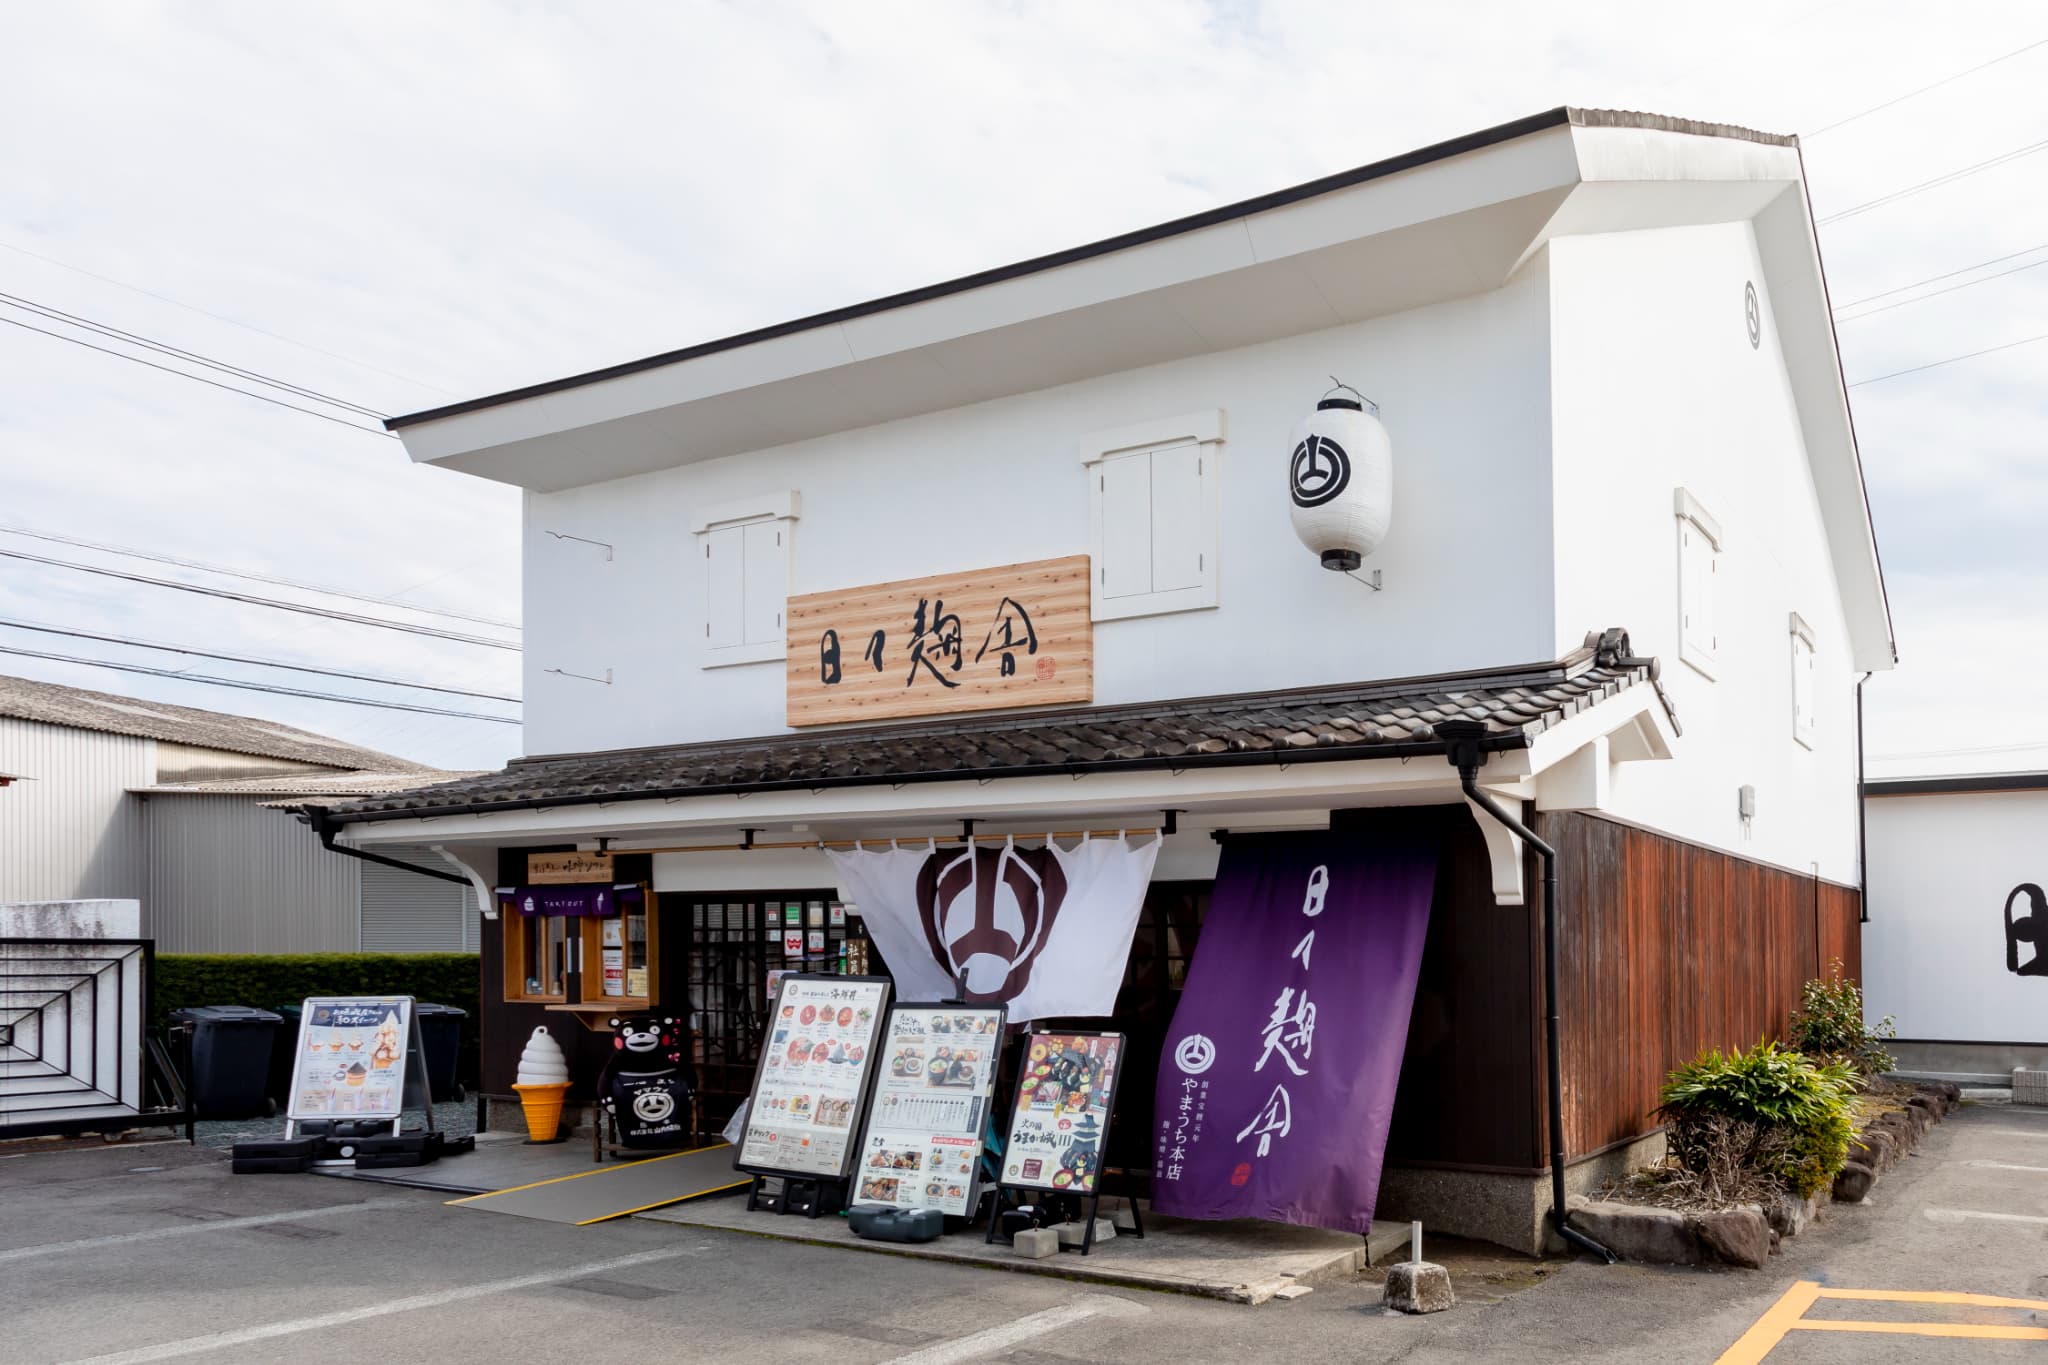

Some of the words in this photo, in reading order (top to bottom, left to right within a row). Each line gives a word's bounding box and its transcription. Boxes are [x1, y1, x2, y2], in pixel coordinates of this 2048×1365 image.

[1166, 1077, 1198, 1181] やまうち本店
